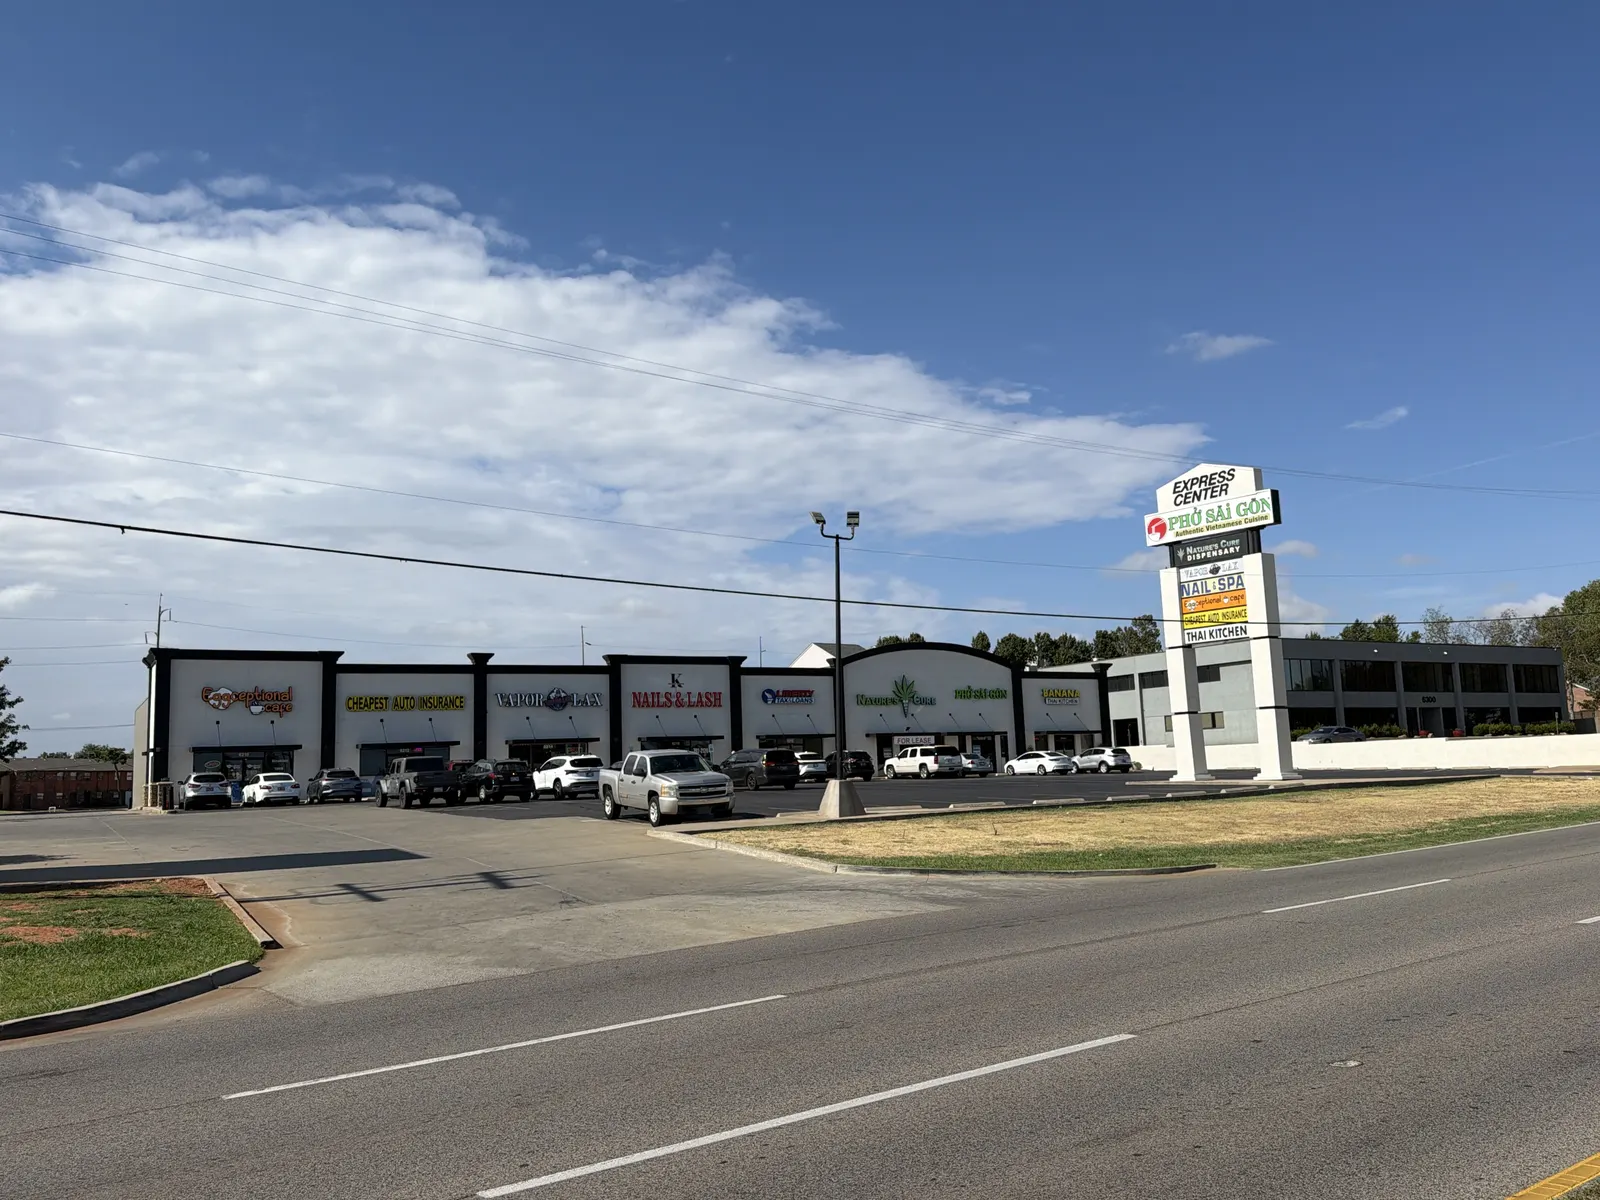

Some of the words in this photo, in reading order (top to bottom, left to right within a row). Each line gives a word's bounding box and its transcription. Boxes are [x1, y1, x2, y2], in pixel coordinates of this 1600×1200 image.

[1172, 468, 1236, 494] EXPRESS
[1173, 483, 1229, 506] CENTER
[1175, 527, 1204, 539] Authentic
[1206, 520, 1243, 532] Vietnamese
[1244, 514, 1269, 525] Cuisine
[1187, 546, 1240, 561] DISPENSARY
[1181, 581, 1211, 596] NAIL
[1218, 575, 1245, 591] SPA
[1184, 614, 1206, 626] CHEAPEST
[1207, 612, 1220, 623] AUTO
[1221, 609, 1248, 620] INSURANCE
[1186, 630, 1206, 642] THAI
[1208, 625, 1248, 639] KITCHEN
[202, 686, 293, 710] Eggceptional
[495, 693, 545, 707] VAPOR
[571, 693, 603, 707] LAX
[631, 691, 673, 708] NAILS
[686, 691, 723, 708] LASH
[1042, 688, 1080, 698] BANANA
[264, 703, 293, 718] cafe
[346, 696, 389, 712] CHEAPEST
[392, 696, 416, 711] AUTO
[418, 695, 465, 711] INSURANCE
